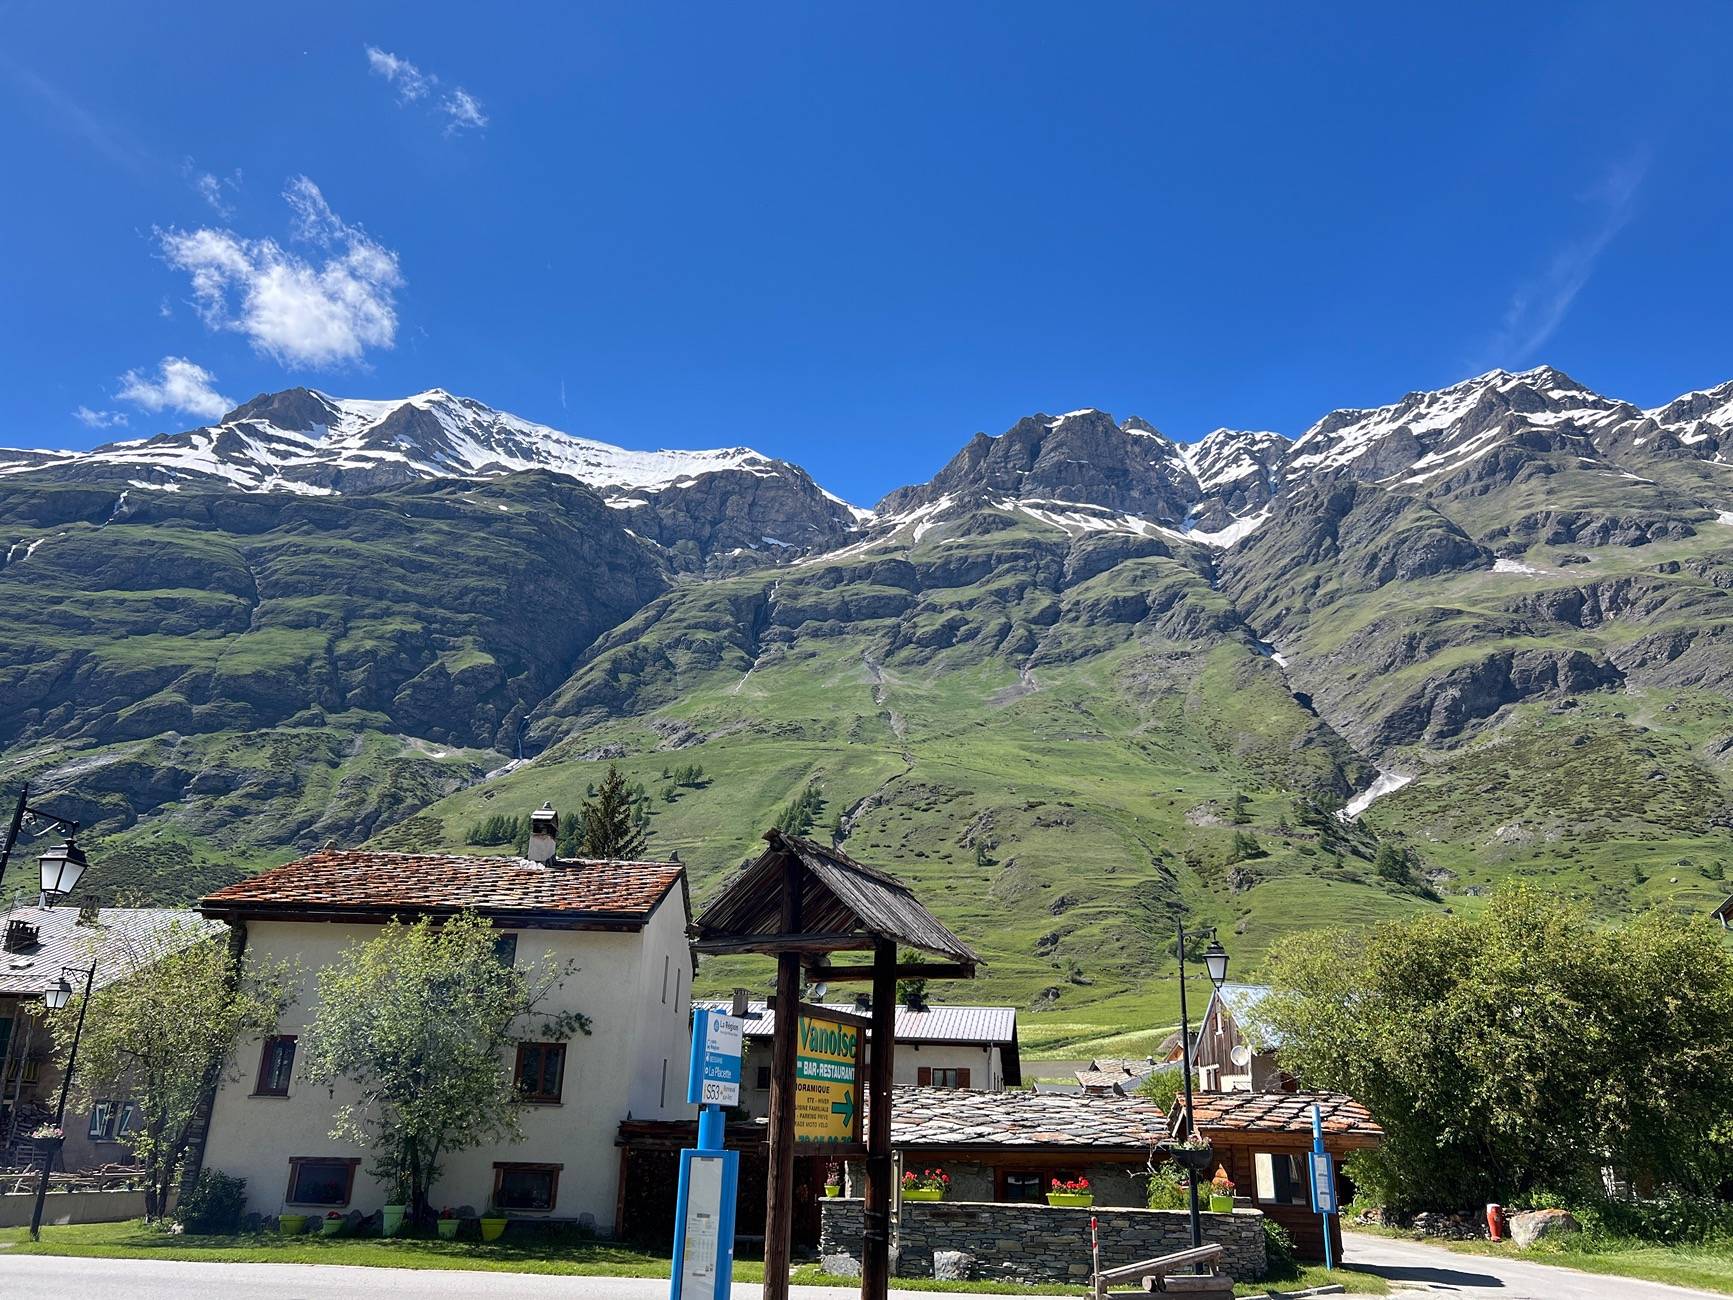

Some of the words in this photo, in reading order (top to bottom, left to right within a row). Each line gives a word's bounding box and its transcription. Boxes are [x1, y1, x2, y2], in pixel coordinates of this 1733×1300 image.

[799, 1016, 857, 1058] Vanoise
[706, 1084, 720, 1100] S53
[795, 1083, 830, 1094] ORAMIQUE
